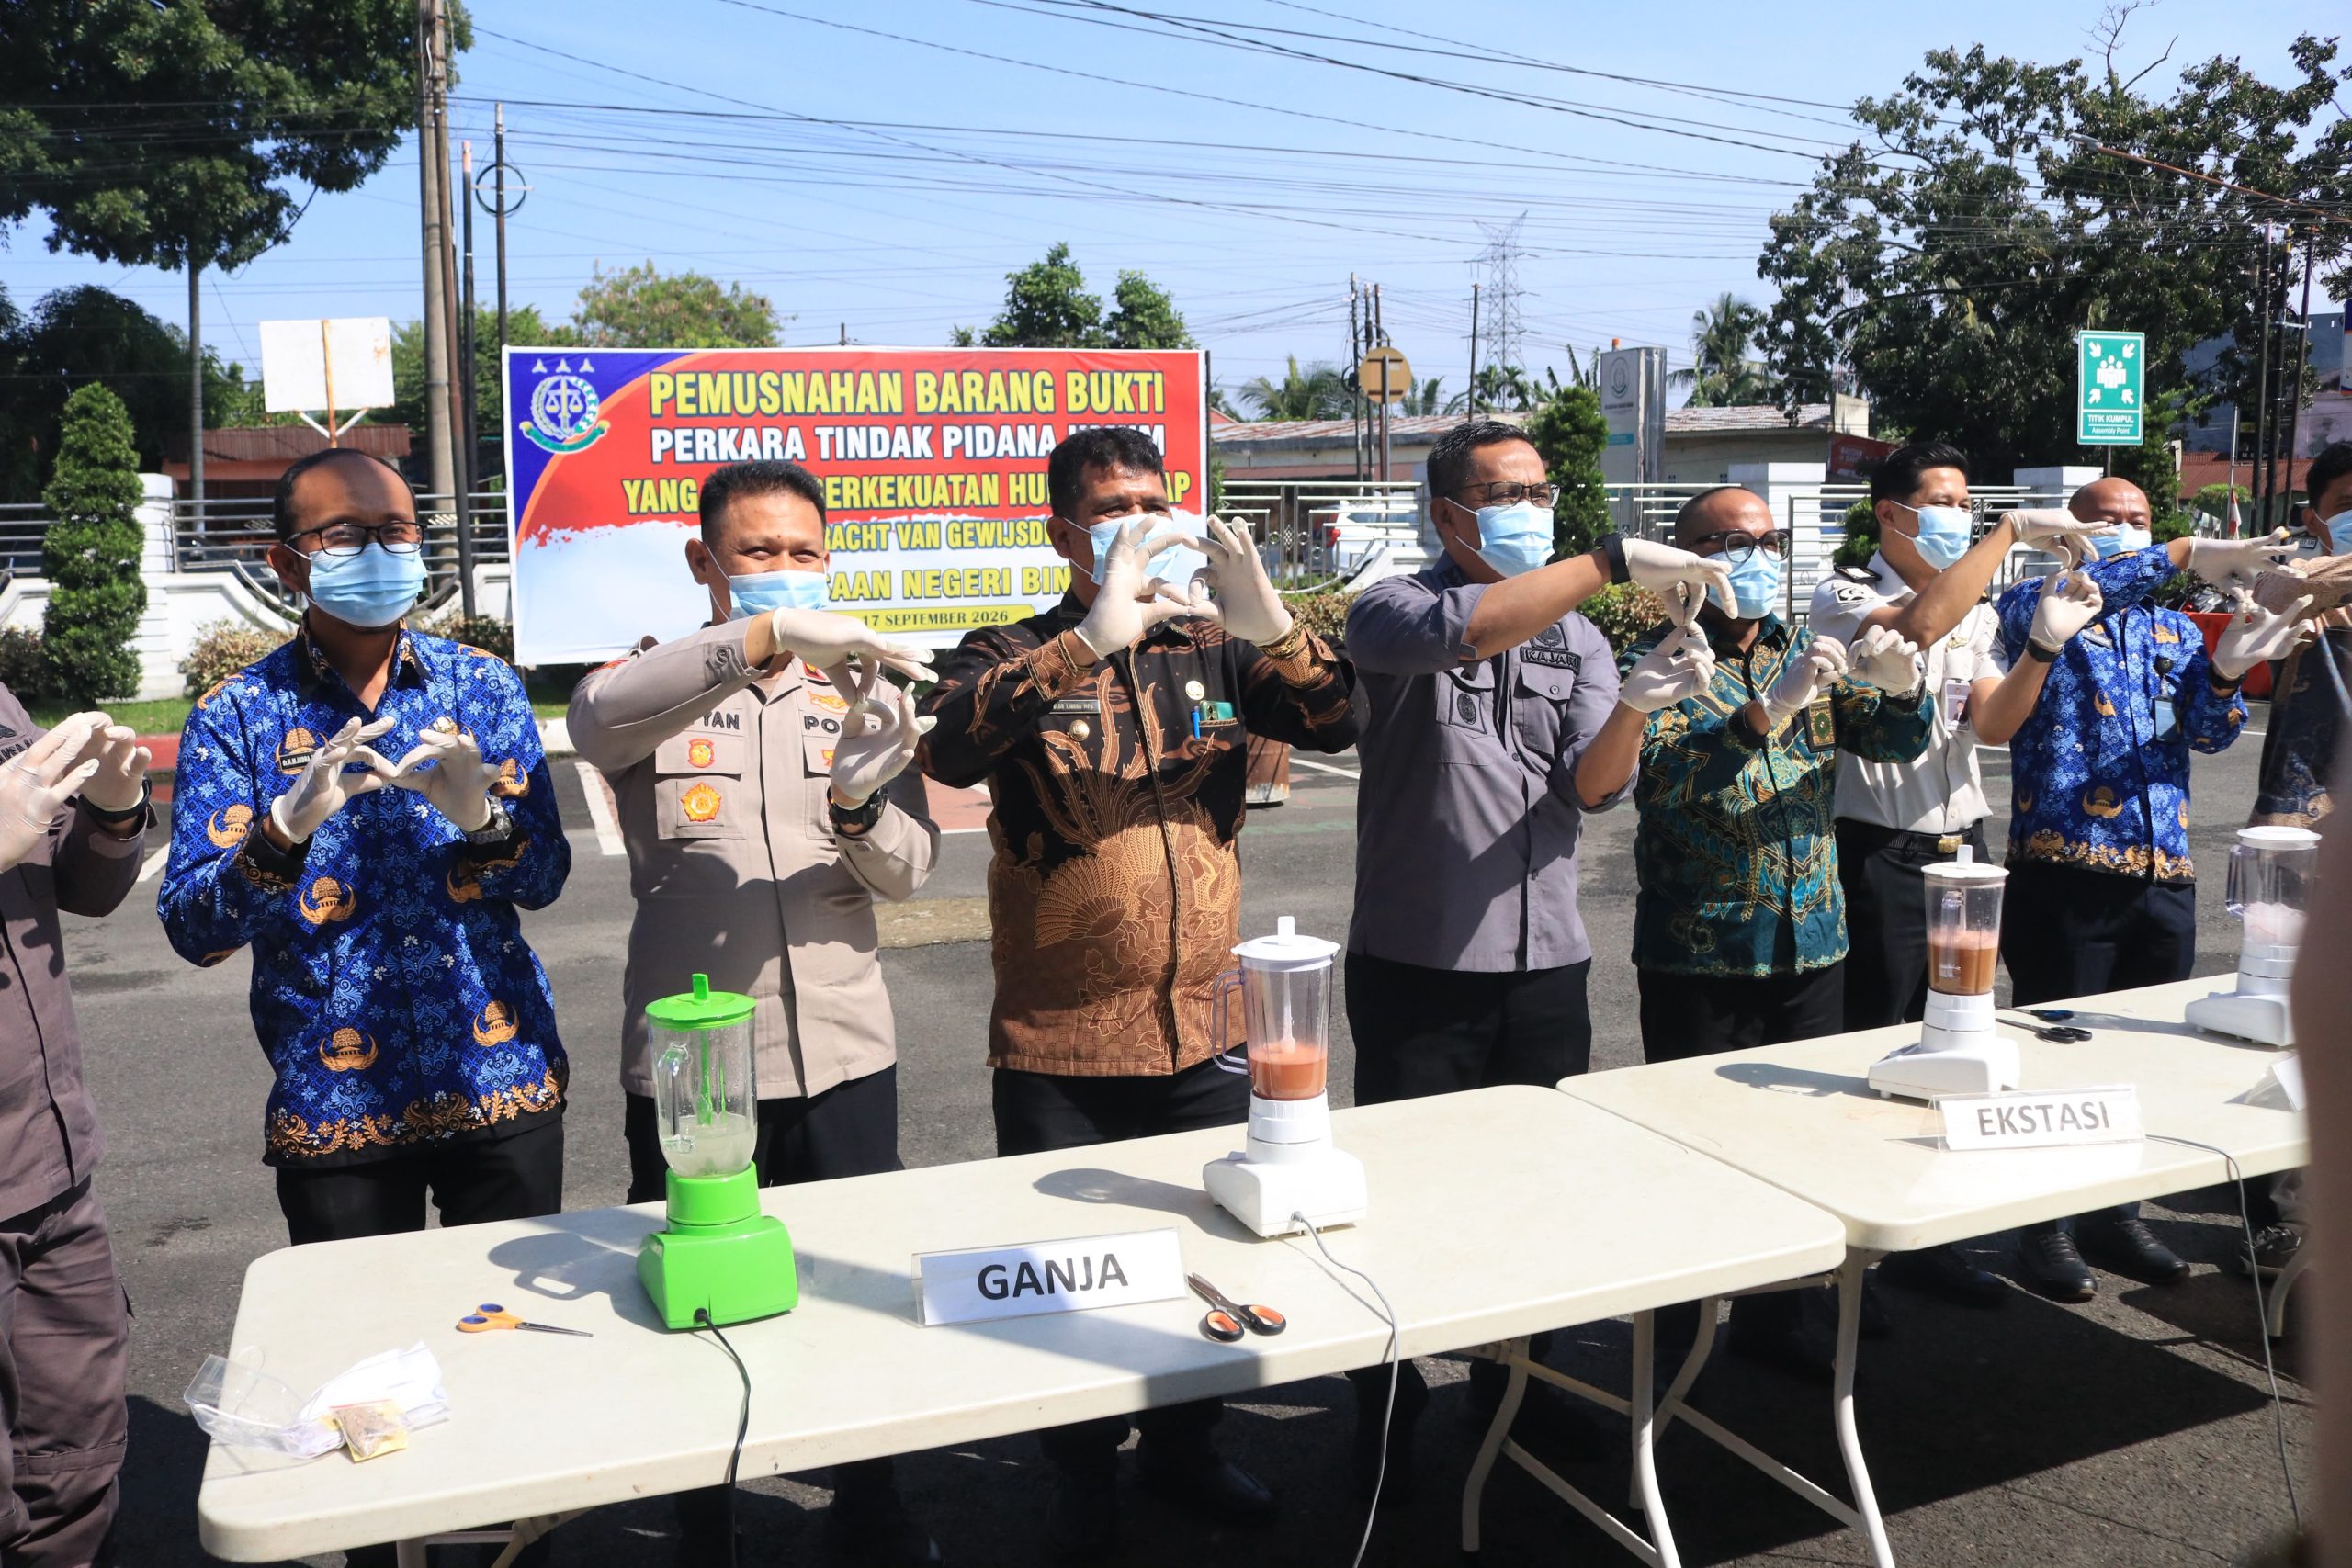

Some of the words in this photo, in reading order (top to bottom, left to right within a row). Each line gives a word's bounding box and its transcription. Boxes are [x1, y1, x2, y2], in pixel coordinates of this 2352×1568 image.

[650, 370, 903, 416] PEMUSNAHAN
[915, 370, 1056, 414] BARANG
[1066, 370, 1165, 413] BUKTI
[2087, 414, 2104, 423] TITIK
[2106, 414, 2134, 423] KUMPUL
[650, 426, 806, 463] PERKARA
[814, 424, 933, 460] TINDAK
[943, 423, 1057, 458] PIDANA
[622, 478, 699, 514] YANG
[817, 472, 1001, 509] ERKEKUATAN
[896, 521, 941, 550] VAN
[902, 567, 1012, 599] NEGERI
[863, 615, 879, 626] 17
[885, 612, 966, 626] SEPTEMBER
[972, 611, 1008, 623] 2026
[1524, 649, 1579, 670] KAJARI
[1977, 1101, 2110, 1137] EKSTASI
[978, 1253, 1129, 1301] GANJA
